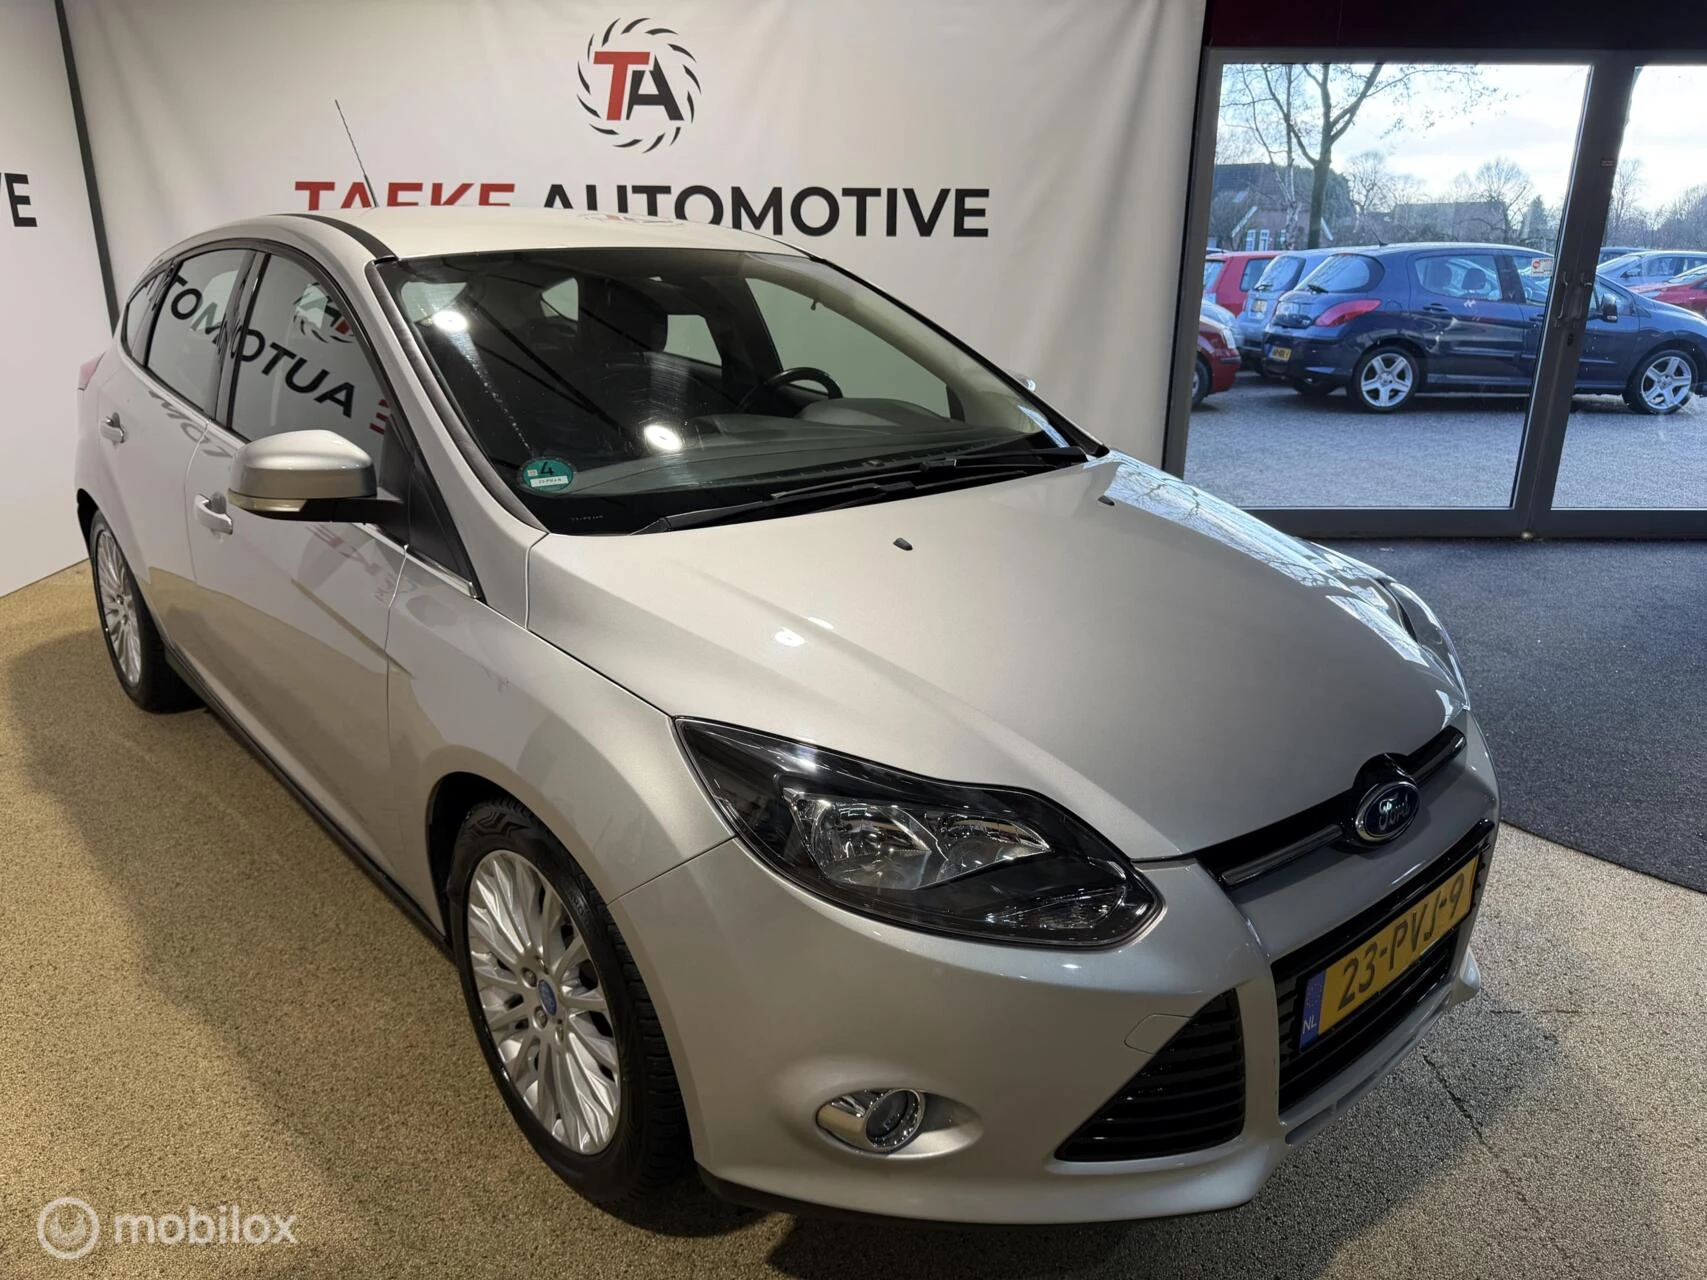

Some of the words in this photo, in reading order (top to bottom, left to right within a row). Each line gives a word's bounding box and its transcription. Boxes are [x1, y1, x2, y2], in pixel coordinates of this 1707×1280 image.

[592, 51, 685, 121] TA
[0, 172, 38, 228] E
[543, 184, 990, 236] AUTOMOTIVE
[540, 461, 554, 475] 4
[1337, 872, 1465, 1012] 23-PVJ-9
[1303, 1017, 1317, 1034] NL
